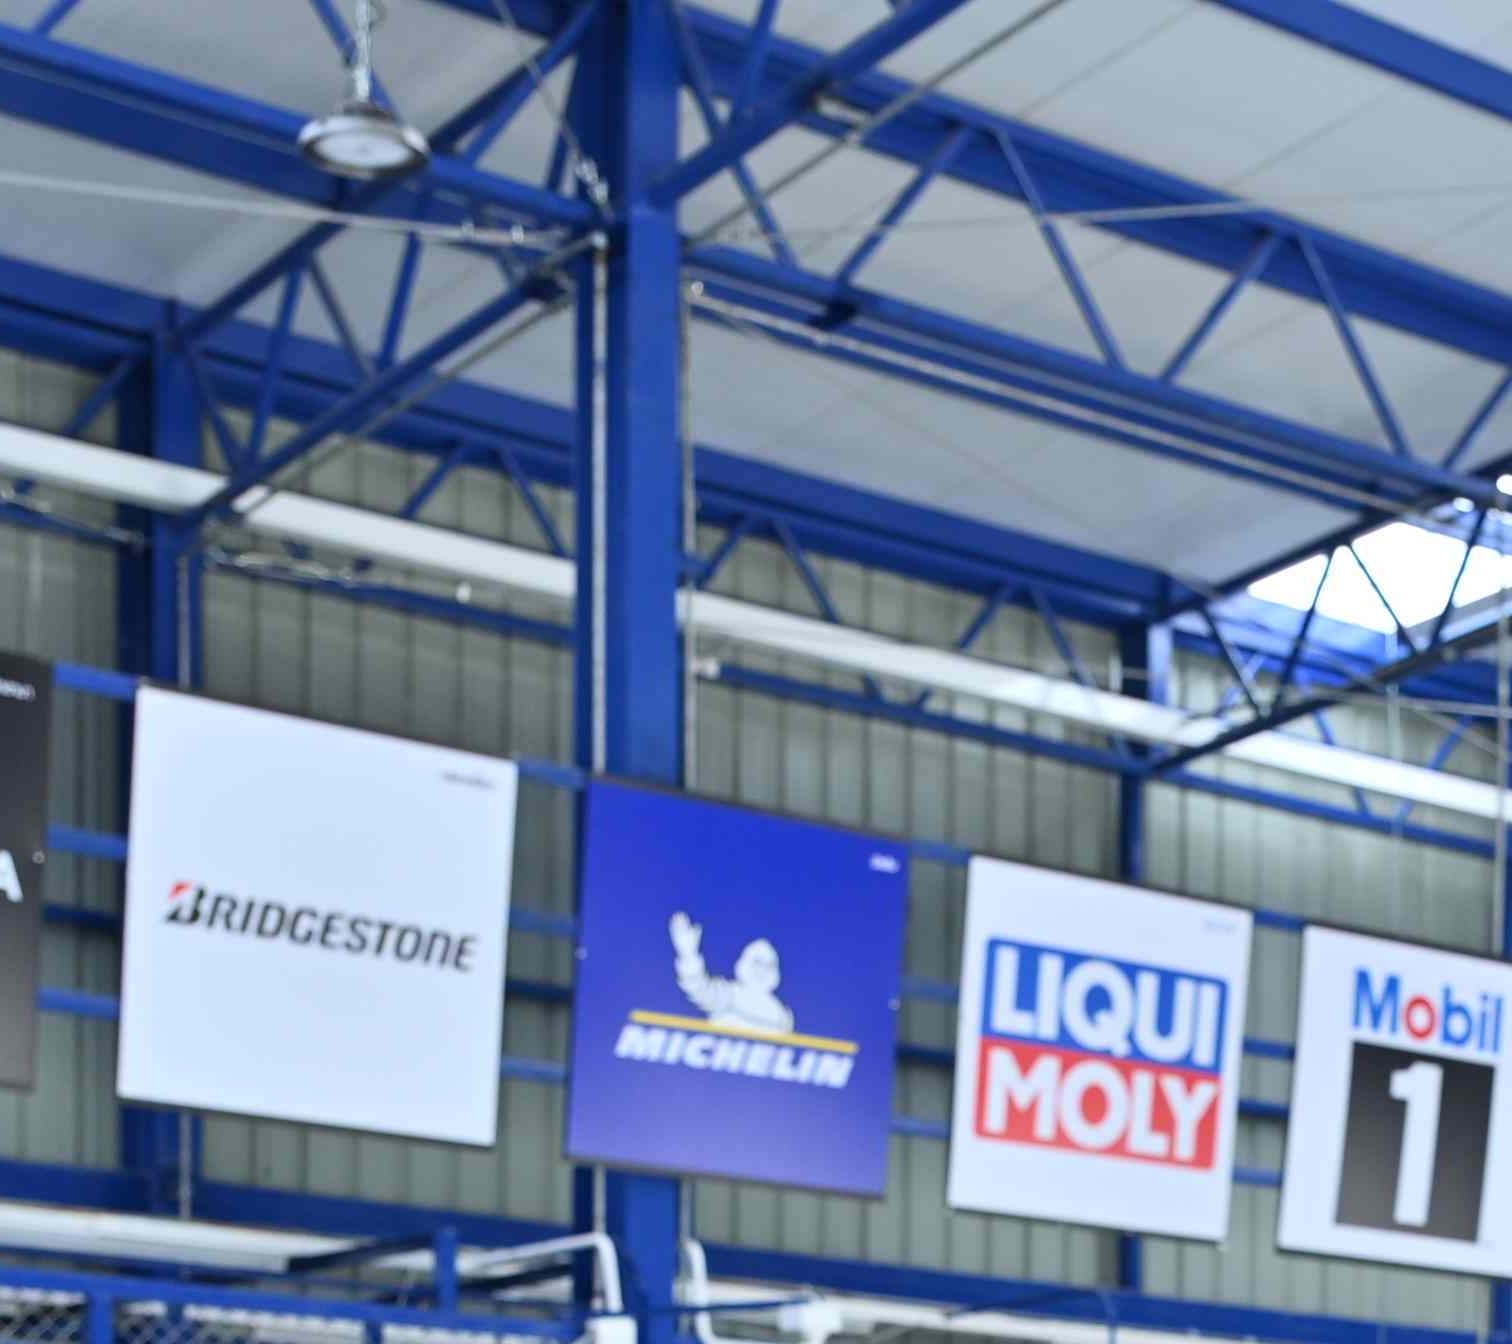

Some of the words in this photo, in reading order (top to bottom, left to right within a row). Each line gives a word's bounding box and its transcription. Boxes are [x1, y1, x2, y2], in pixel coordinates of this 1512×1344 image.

[163, 882, 478, 973] BRIDGESTONE
[615, 1023, 854, 1089] MICHELIN
[990, 948, 1226, 1070] LIQUI
[1353, 968, 1504, 1055] Mobil
[983, 1049, 1219, 1163] MOLY
[1389, 1060, 1444, 1228] 1
